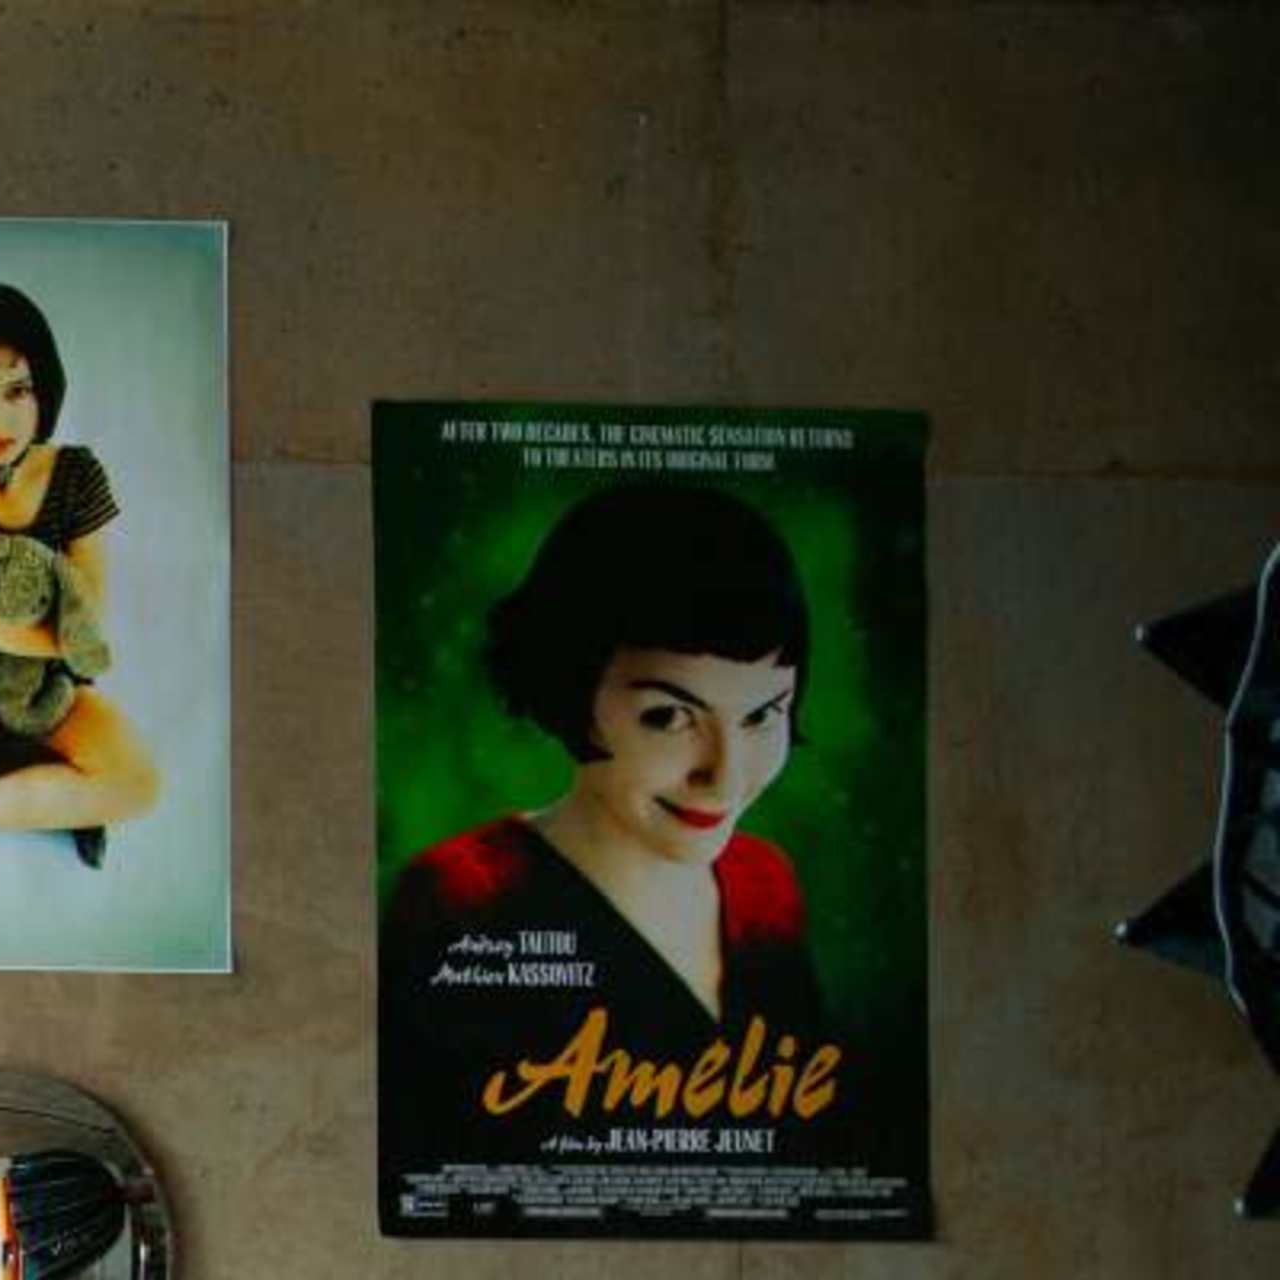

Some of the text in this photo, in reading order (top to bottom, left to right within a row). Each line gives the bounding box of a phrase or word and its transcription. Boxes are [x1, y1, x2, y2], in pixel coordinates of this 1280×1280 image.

[441, 420, 487, 443] AFTER
[491, 421, 524, 443] TWO
[599, 423, 627, 445] THE
[629, 424, 705, 447] CINEMATIC
[708, 425, 786, 448] SENSATION
[789, 427, 854, 449] RETURNS
[523, 447, 543, 469] TO
[665, 450, 730, 471] ORIGINAL
[519, 930, 578, 955] TAUTOU
[506, 962, 596, 987] KASSOVITZ
[608, 1128, 712, 1153] JEAN-PIERRE
[714, 1128, 776, 1153] JEUNET
